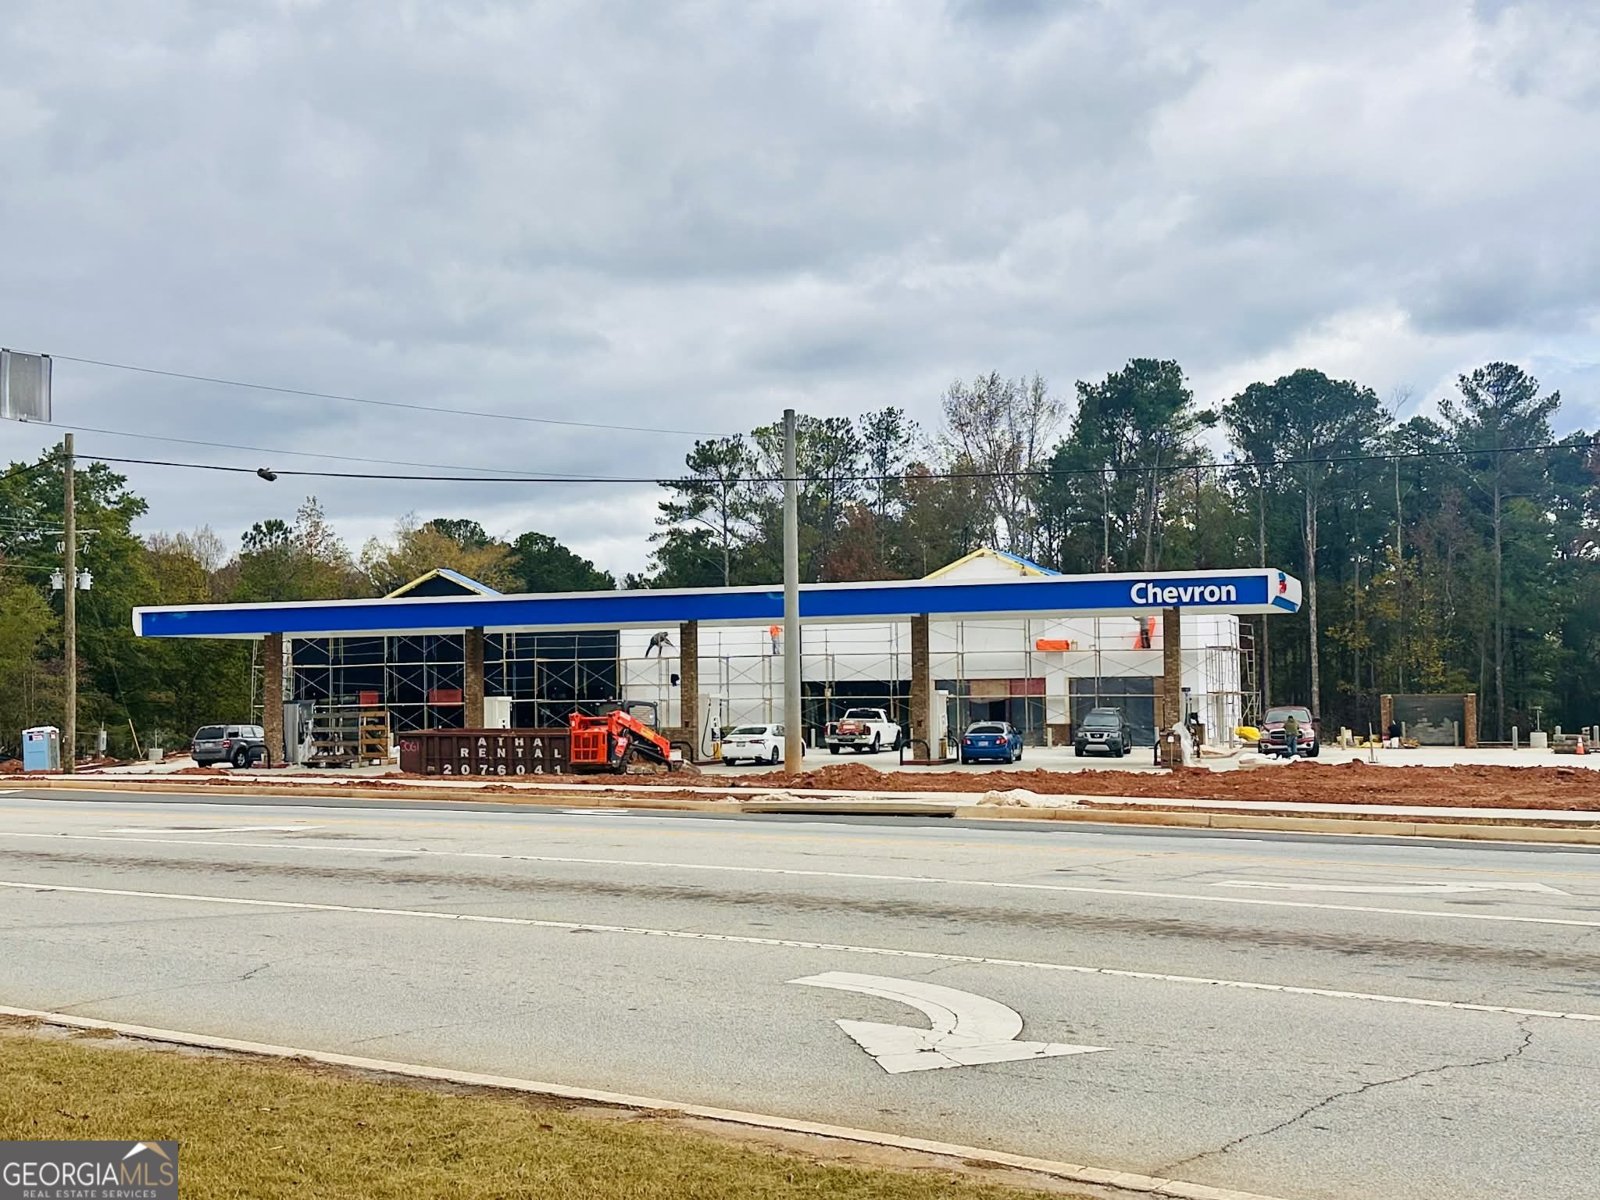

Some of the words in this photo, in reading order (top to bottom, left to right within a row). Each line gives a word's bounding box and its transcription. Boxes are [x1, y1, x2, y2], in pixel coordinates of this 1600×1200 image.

[1130, 582, 1237, 604] Chevron
[478, 737, 543, 746] ATHA
[460, 748, 562, 758] RENTAL
[443, 764, 563, 775] 207-6041
